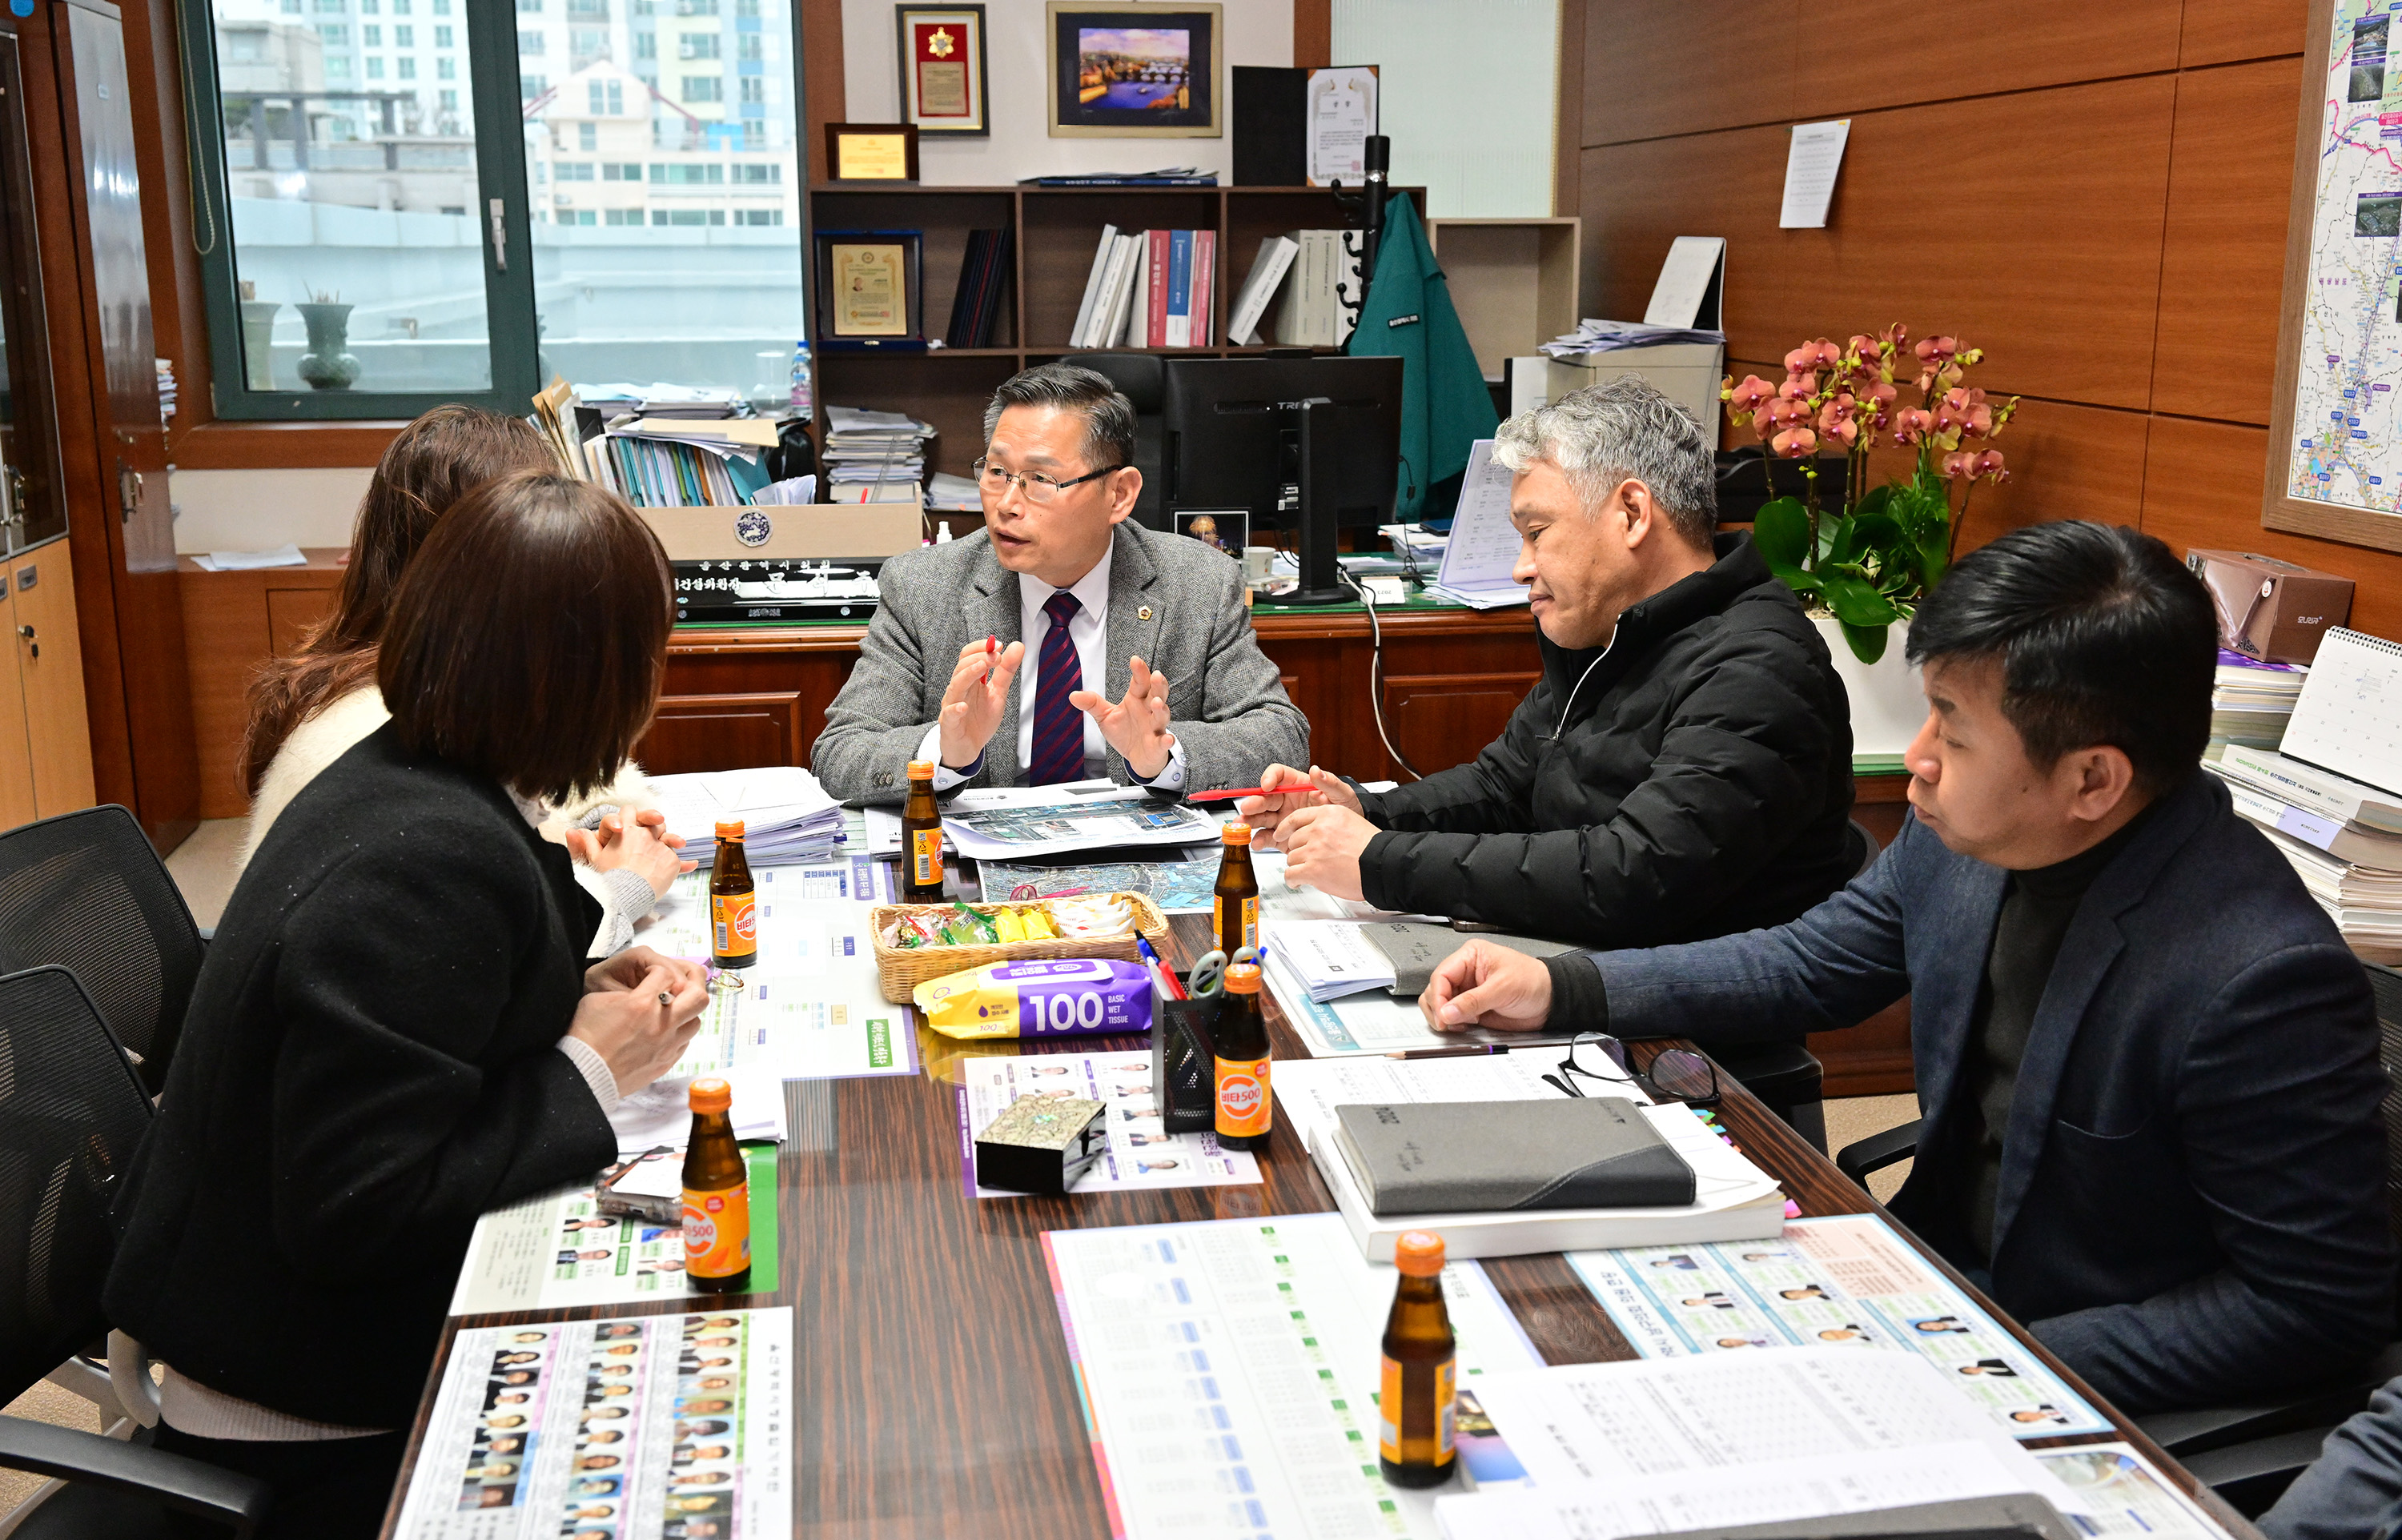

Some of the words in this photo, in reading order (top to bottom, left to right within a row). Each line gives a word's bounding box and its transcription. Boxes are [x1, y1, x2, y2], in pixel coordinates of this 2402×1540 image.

[674, 577, 739, 591] 건설위원장
[737, 916, 757, 931] 비타5
[1107, 994, 1126, 1004] BASIC
[1030, 991, 1104, 1032] 100
[1107, 1005, 1121, 1014] WET
[1107, 1015, 1129, 1025] TISSUE
[1221, 1087, 1260, 1102] 비타500
[684, 1224, 714, 1237] 타500
